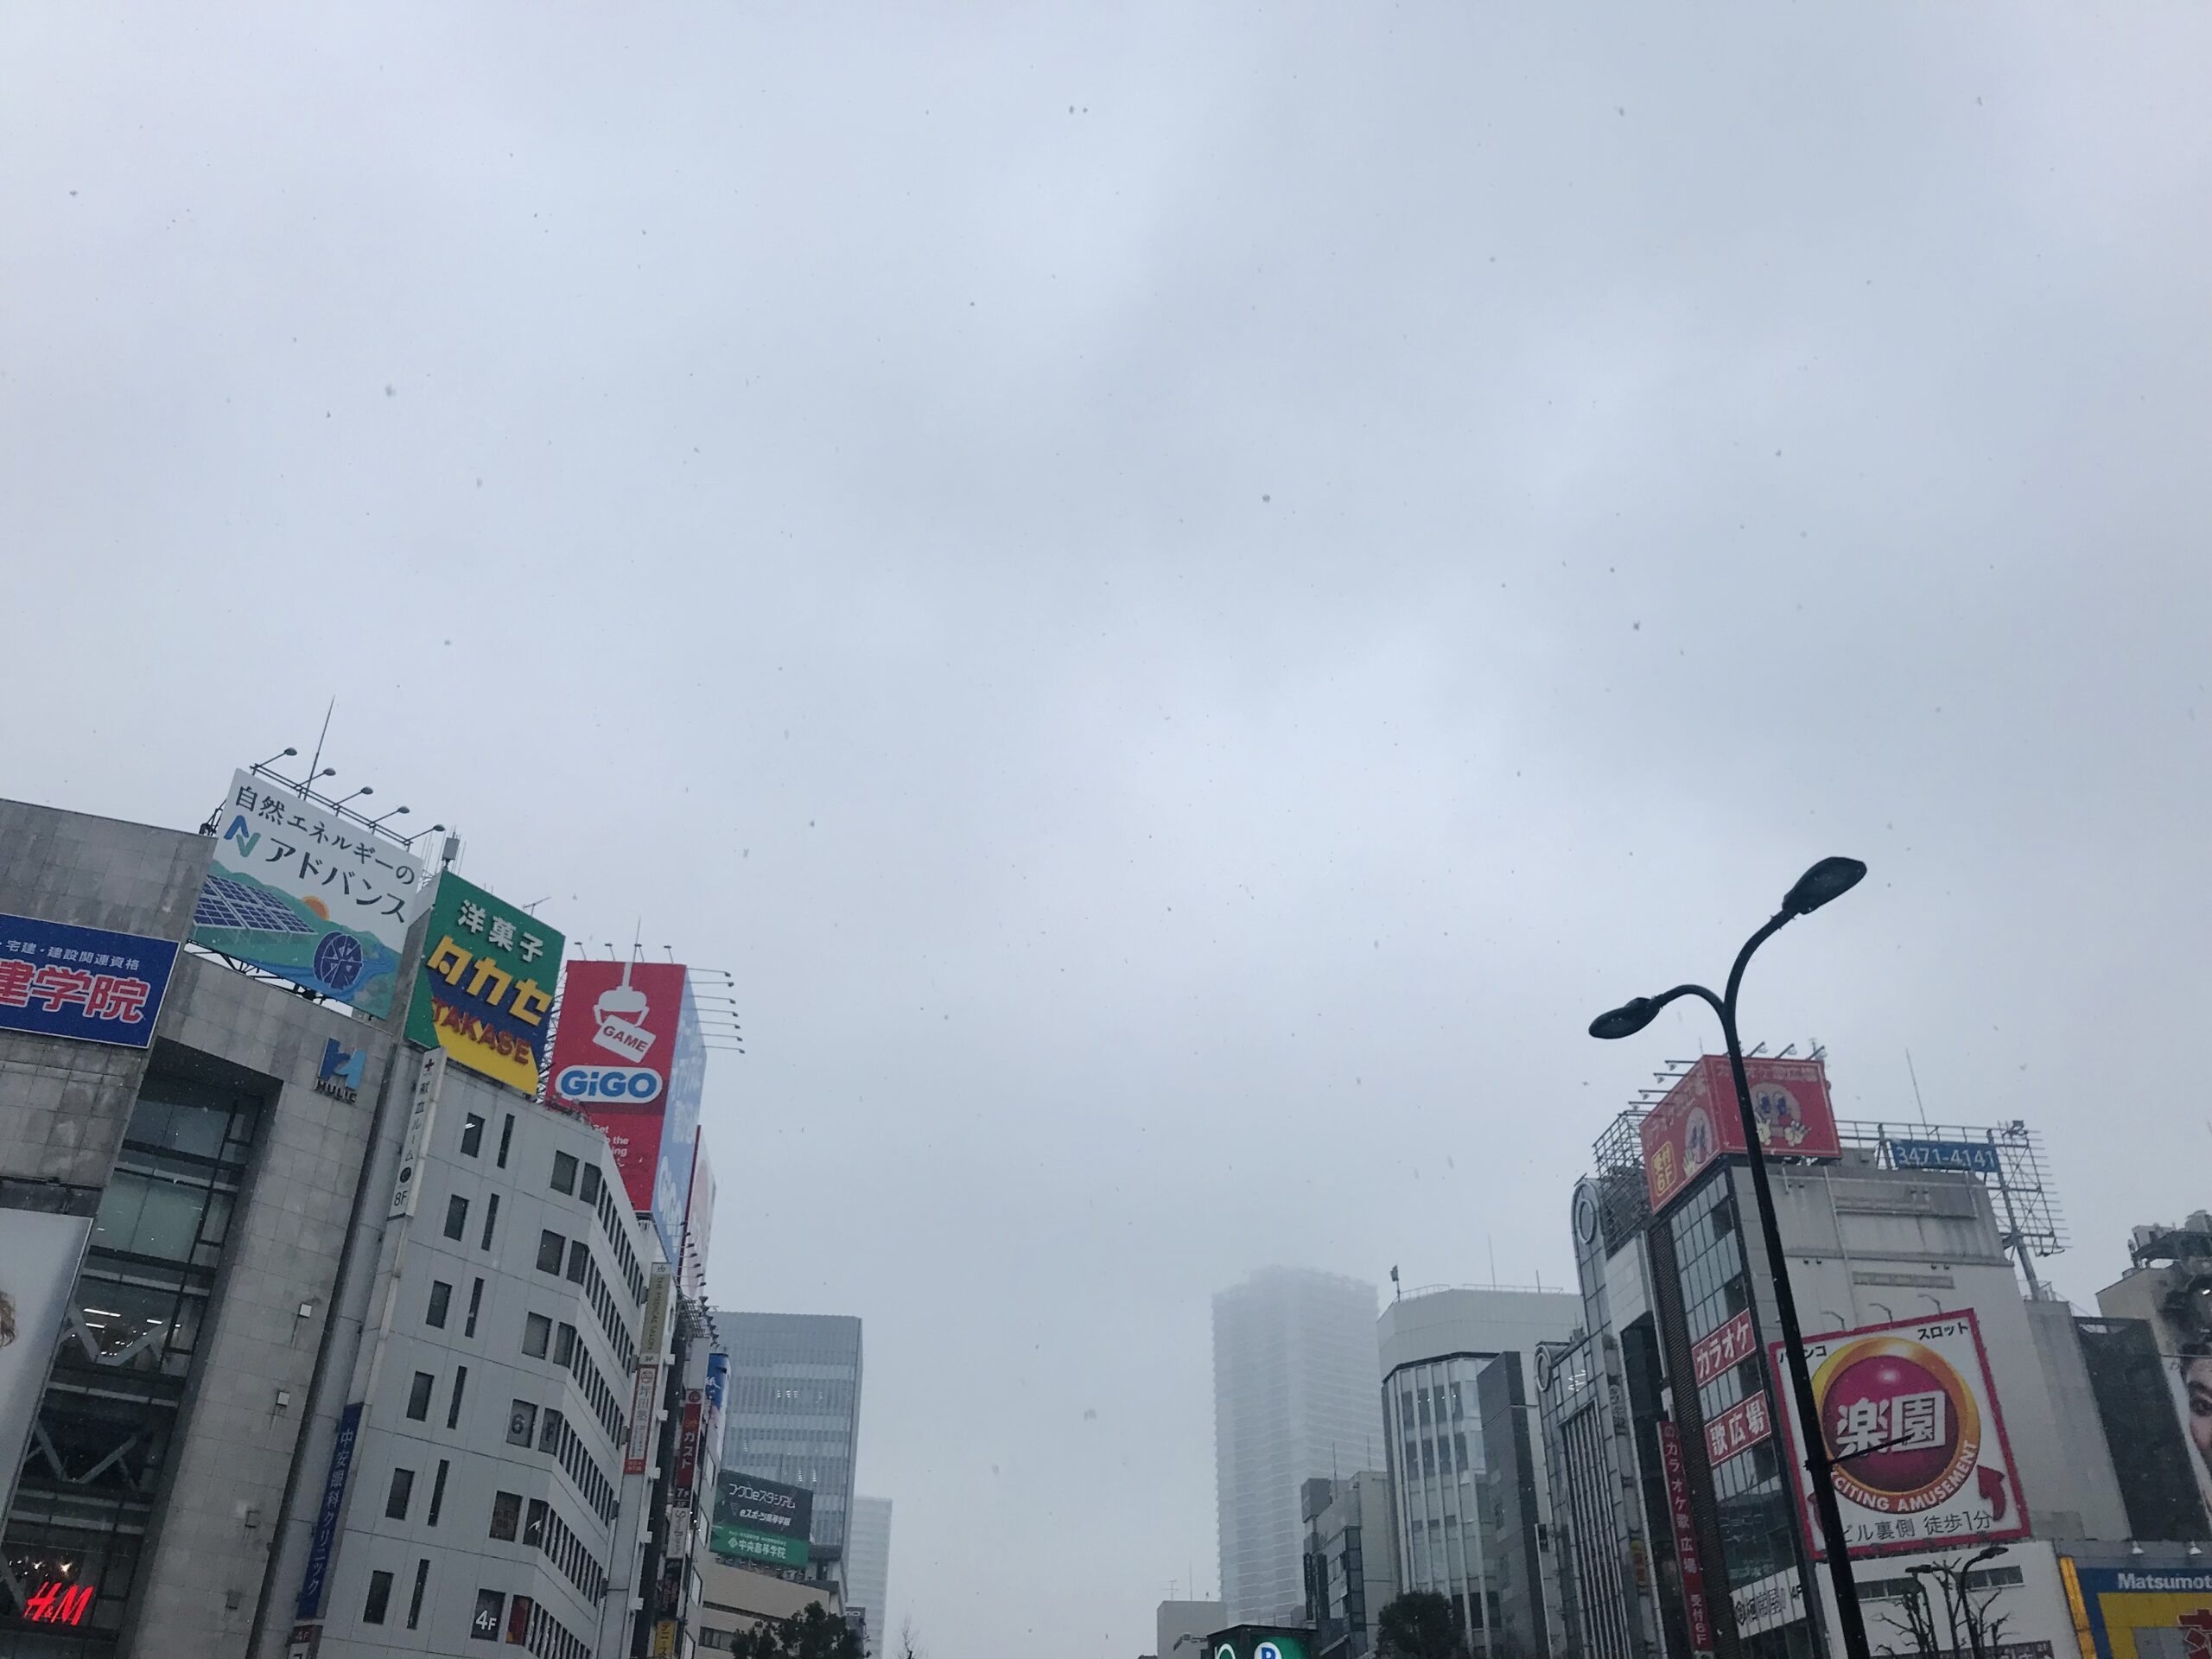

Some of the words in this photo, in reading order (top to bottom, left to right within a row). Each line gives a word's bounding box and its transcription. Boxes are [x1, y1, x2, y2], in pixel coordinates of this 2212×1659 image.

[236, 786, 415, 885] 自然エネルギーの
[266, 837, 405, 923] アドバンス
[458, 899, 544, 963] 洋菓子
[427, 935, 553, 1027] タカセ
[432, 995, 532, 1065] TAKASE
[603, 1026, 648, 1052] GAME
[315, 1080, 357, 1103] HULIC
[405, 1081, 430, 1162] 献血ルーム
[613, 1136, 629, 1145] the
[1897, 1147, 1996, 1167] 3471-4141
[394, 1190, 408, 1206] 8F
[1697, 1320, 1749, 1379] カラオケ
[1917, 1321, 1968, 1340] スロット
[1710, 1400, 1764, 1456] 歌広場
[1836, 1389, 1946, 1459] 楽園
[682, 1432, 695, 1469] ガスト
[1897, 1440, 1977, 1511] AMUSEMENT
[308, 1428, 353, 1596] 中安眼科クリニック
[739, 1539, 787, 1560] 中央高等学院
[23, 1581, 94, 1625] H&M
[476, 1610, 497, 1630] 4F
[296, 1630, 310, 1641] 4F
